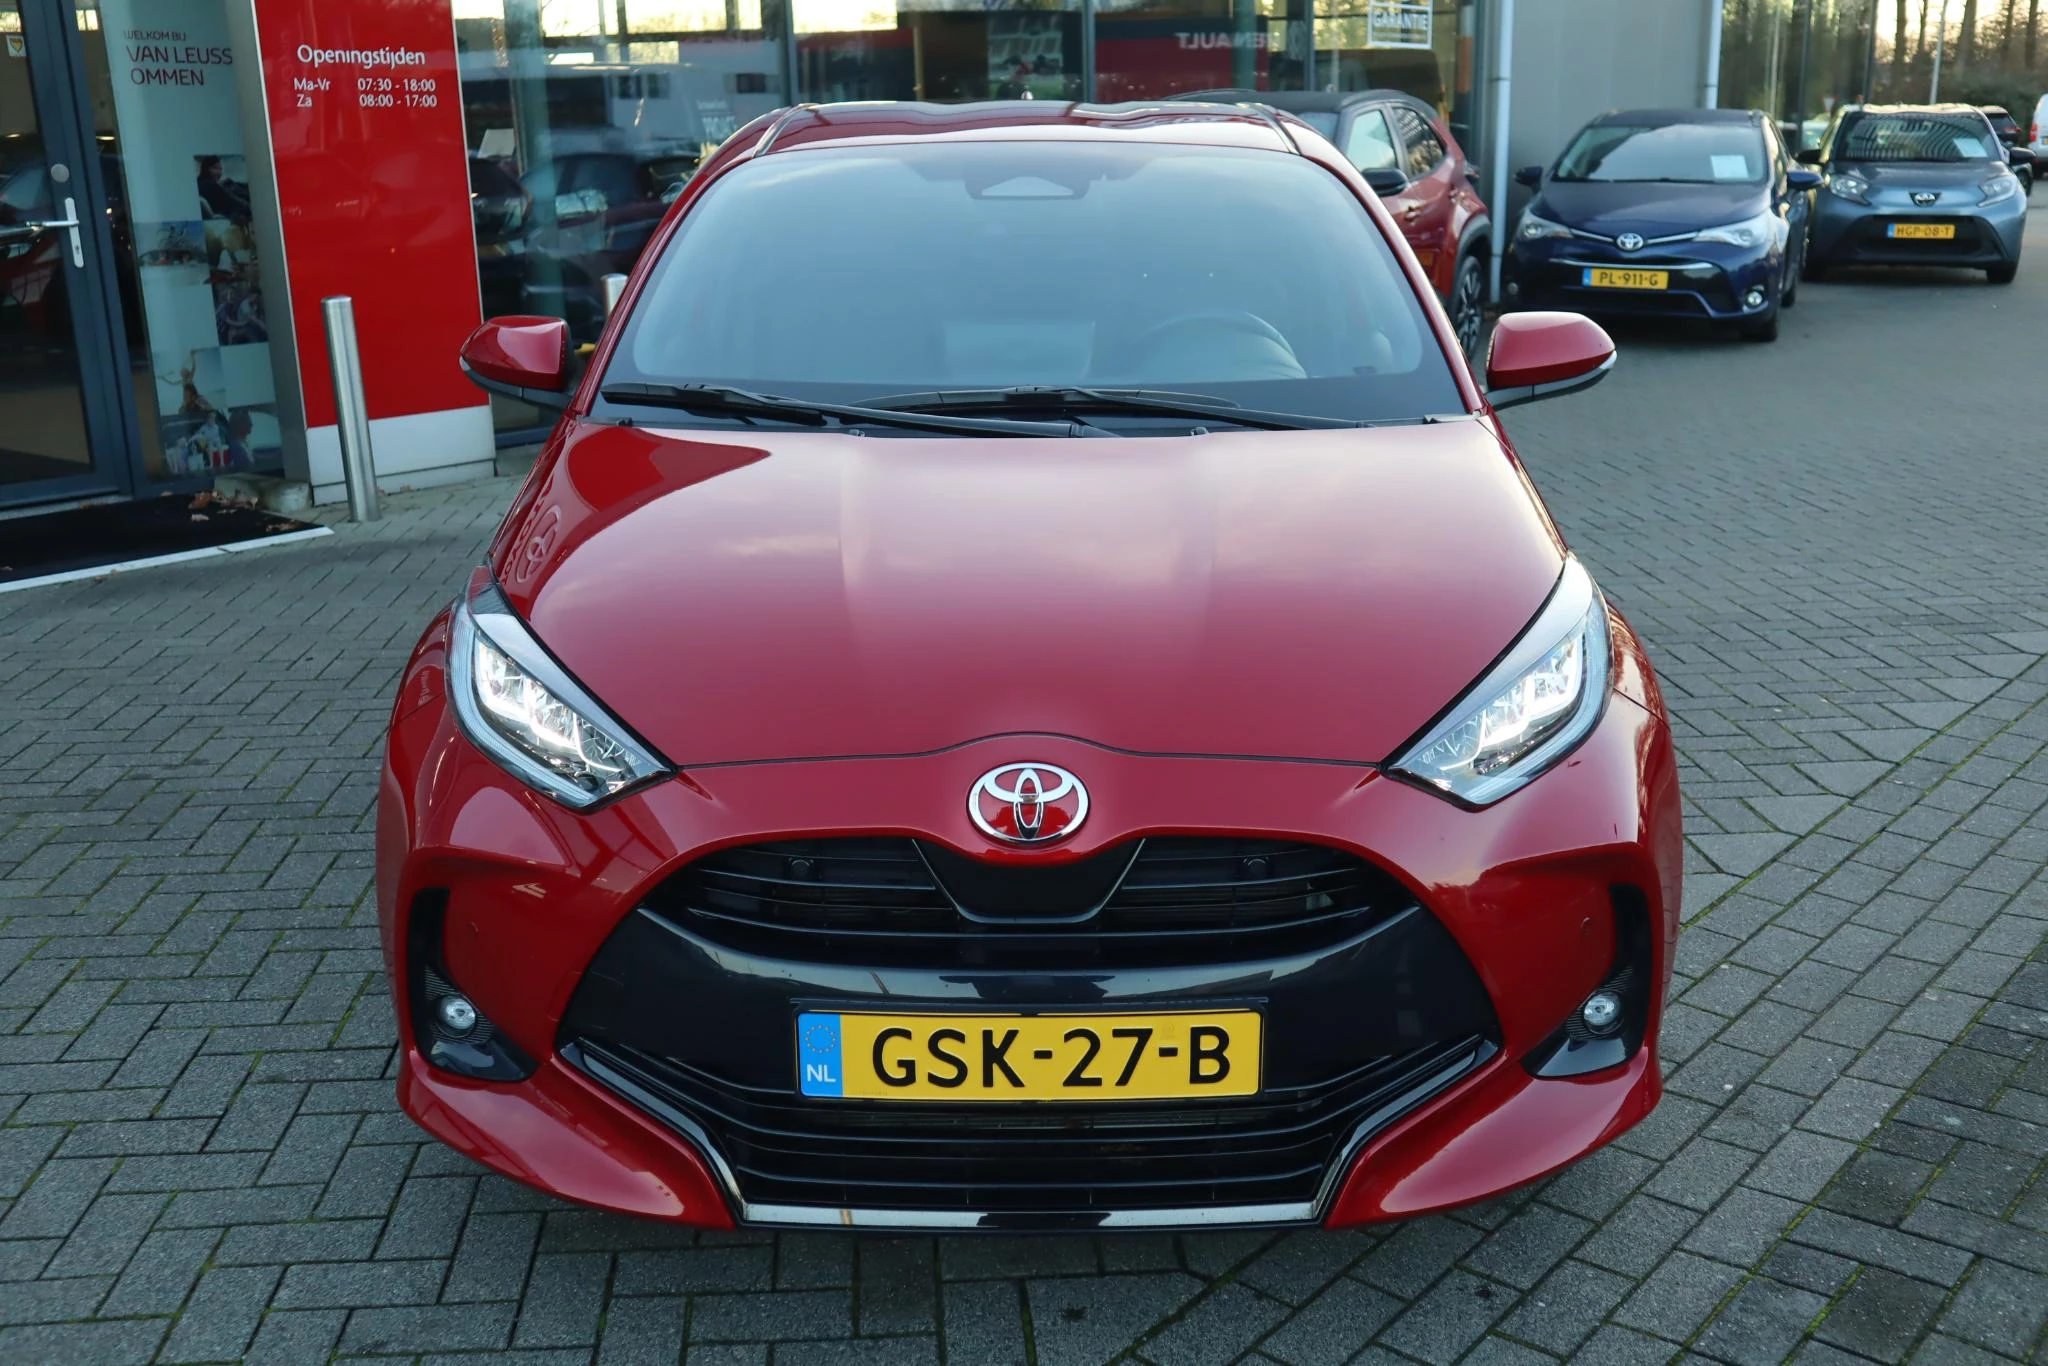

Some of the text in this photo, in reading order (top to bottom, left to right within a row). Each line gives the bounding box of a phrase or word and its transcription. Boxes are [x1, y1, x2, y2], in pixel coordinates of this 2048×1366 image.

[124, 30, 169, 41] WELKOM
[126, 45, 169, 63] VAN
[297, 44, 426, 70] Openingstijden
[130, 67, 205, 86] OMMEN
[293, 77, 331, 91] Ma-Vr
[357, 78, 392, 91] 07:30
[402, 78, 436, 92] 18:00
[296, 94, 313, 107] Za
[359, 94, 393, 107] 08:00
[404, 94, 438, 108] 17:00
[1599, 271, 1659, 287] PL-911-G
[871, 1025, 1231, 1089] GSK-27-B
[806, 1063, 837, 1084] NL
